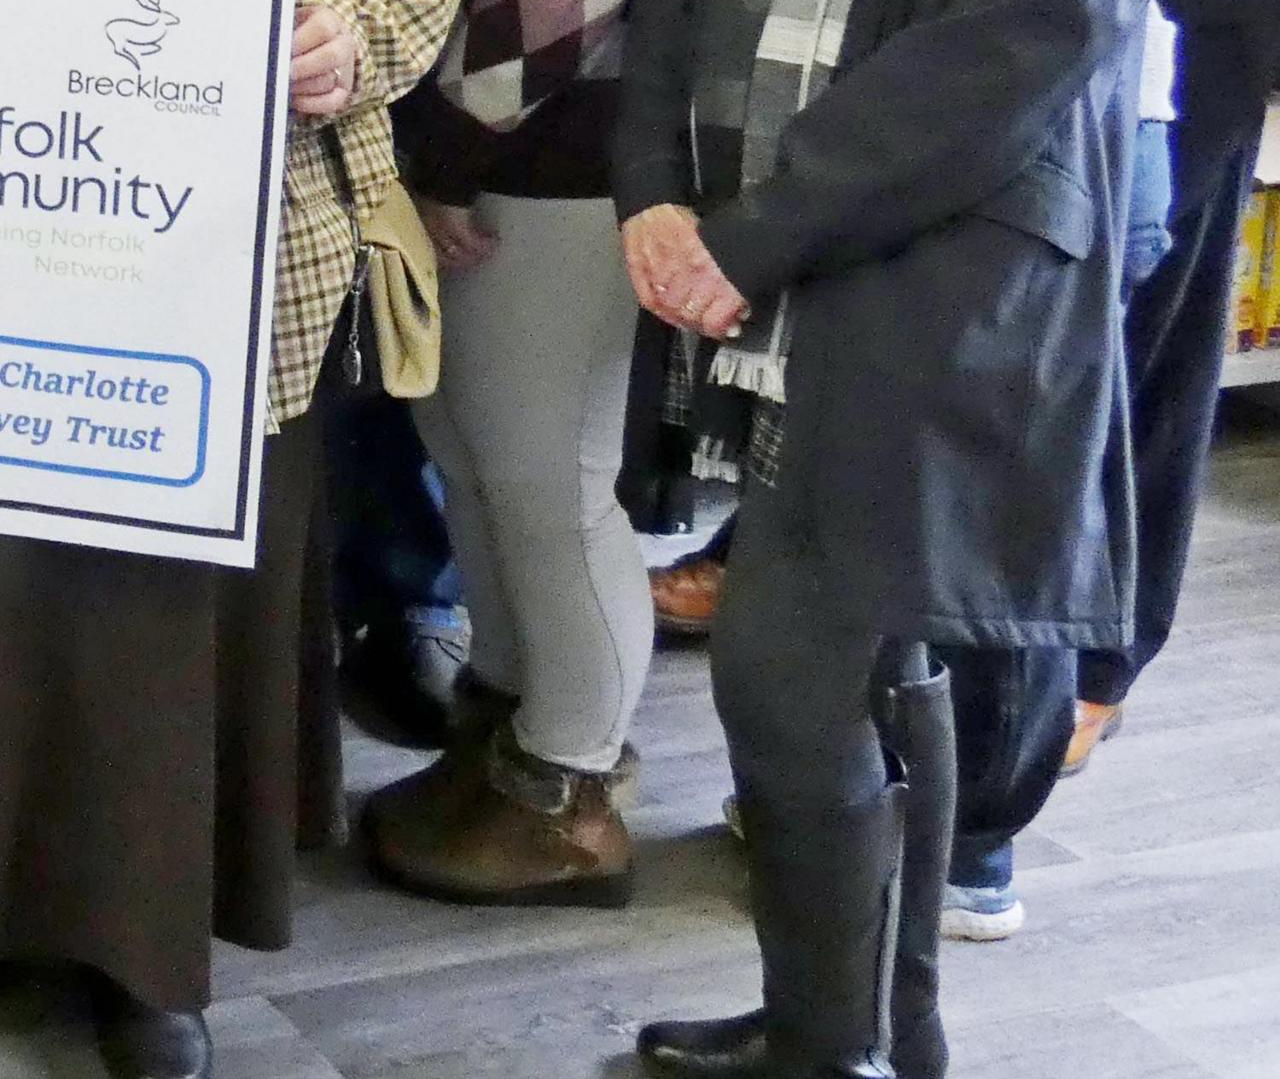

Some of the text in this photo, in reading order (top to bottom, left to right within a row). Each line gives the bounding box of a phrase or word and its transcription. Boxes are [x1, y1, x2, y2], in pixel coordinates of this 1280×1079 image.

[67, 70, 223, 104] Breckland
[154, 100, 220, 116] COUNCIL
[50, 226, 145, 254] Norfolk
[34, 255, 142, 283] Network
[67, 416, 166, 452] Trust
